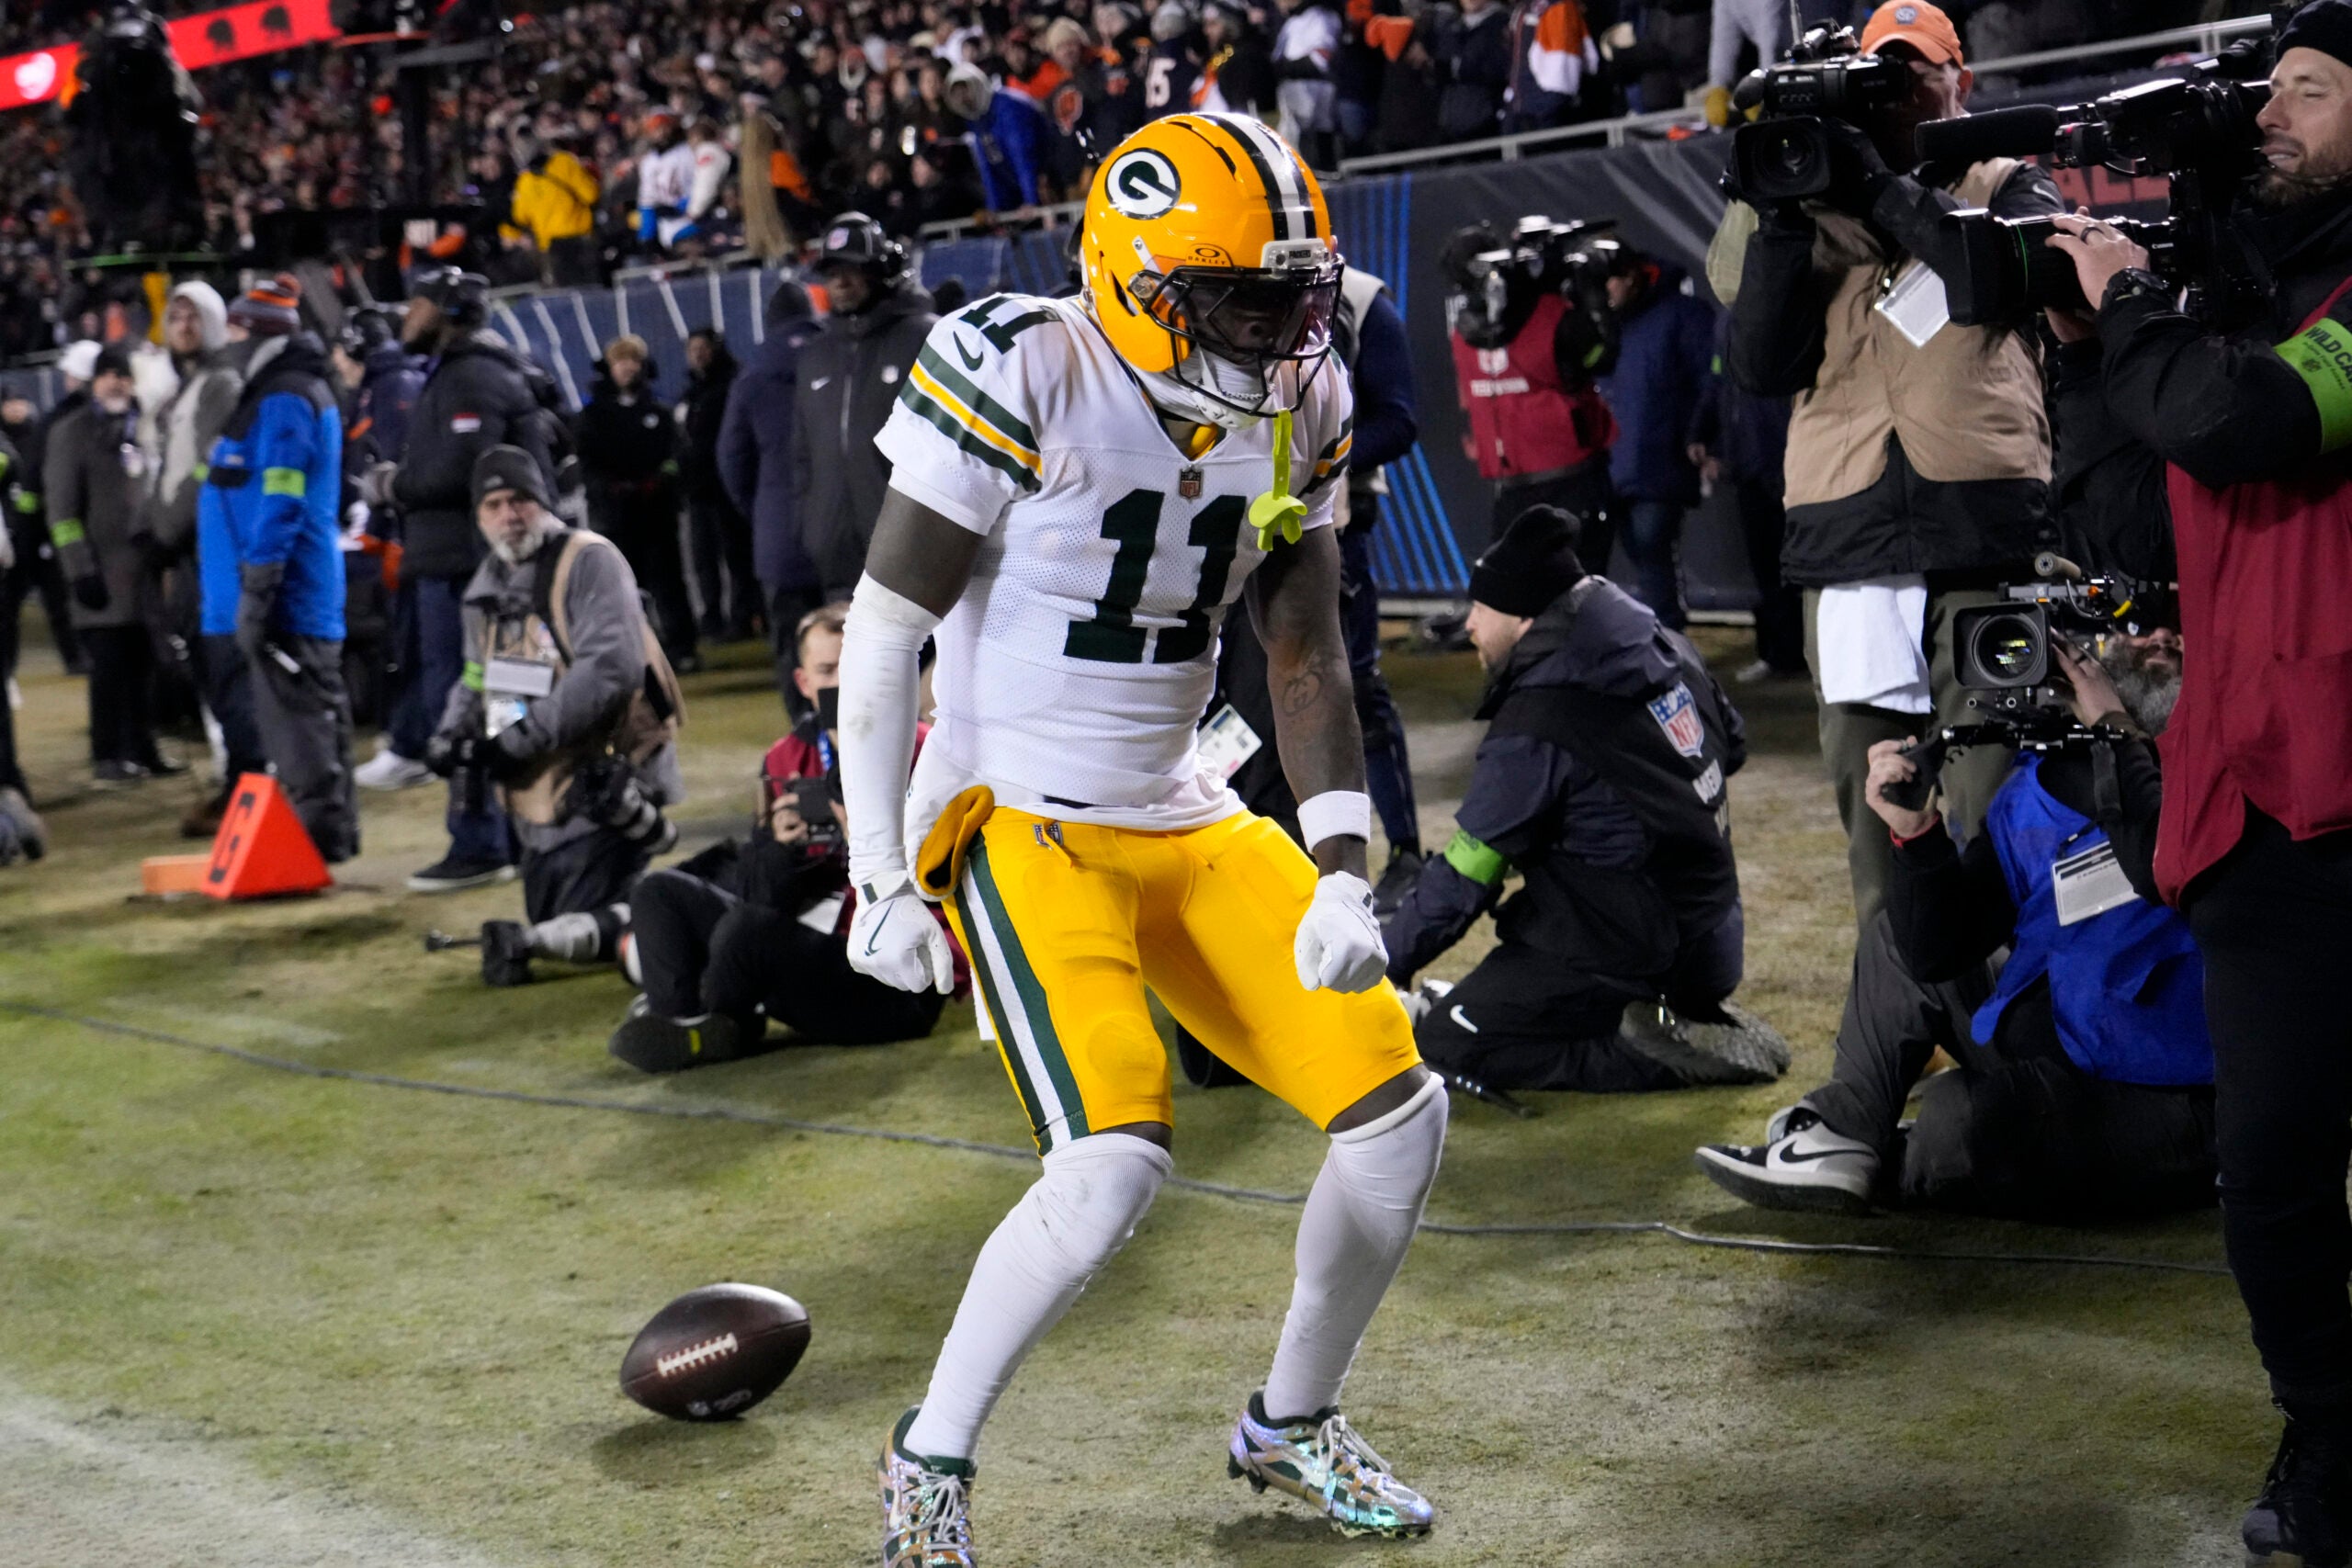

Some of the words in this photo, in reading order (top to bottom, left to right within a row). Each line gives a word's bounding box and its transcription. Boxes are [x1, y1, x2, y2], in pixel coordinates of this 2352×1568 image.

[1106, 149, 1180, 218] G
[1187, 255, 1227, 265] OAKLEY
[958, 296, 1063, 355] 11
[2304, 326, 2342, 354] WILD
[1063, 488, 1247, 664] 11
[1668, 708, 1702, 748] NFL
